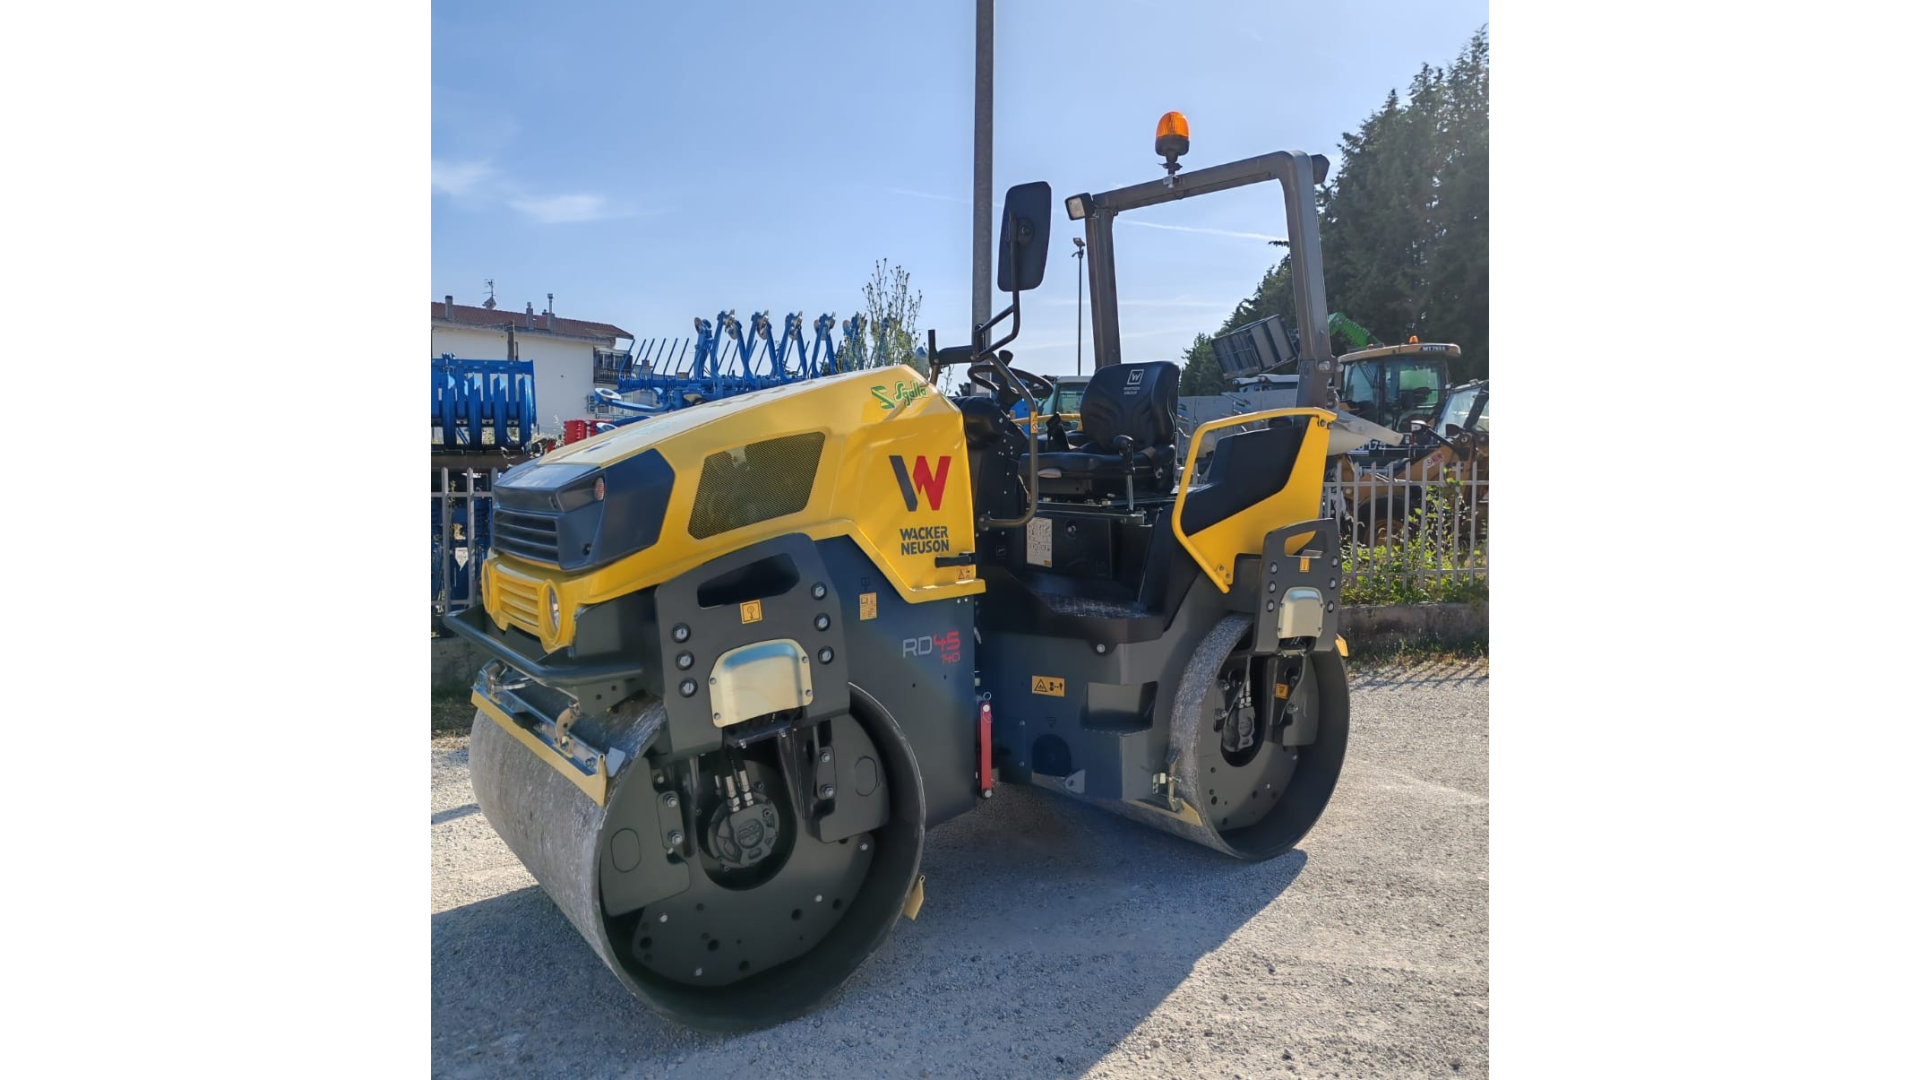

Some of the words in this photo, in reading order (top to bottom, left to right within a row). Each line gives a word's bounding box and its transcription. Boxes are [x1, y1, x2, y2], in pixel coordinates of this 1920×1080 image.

[900, 526, 948, 541] WACKER
[901, 540, 949, 555] NEUSON
[902, 631, 961, 658] RD45
